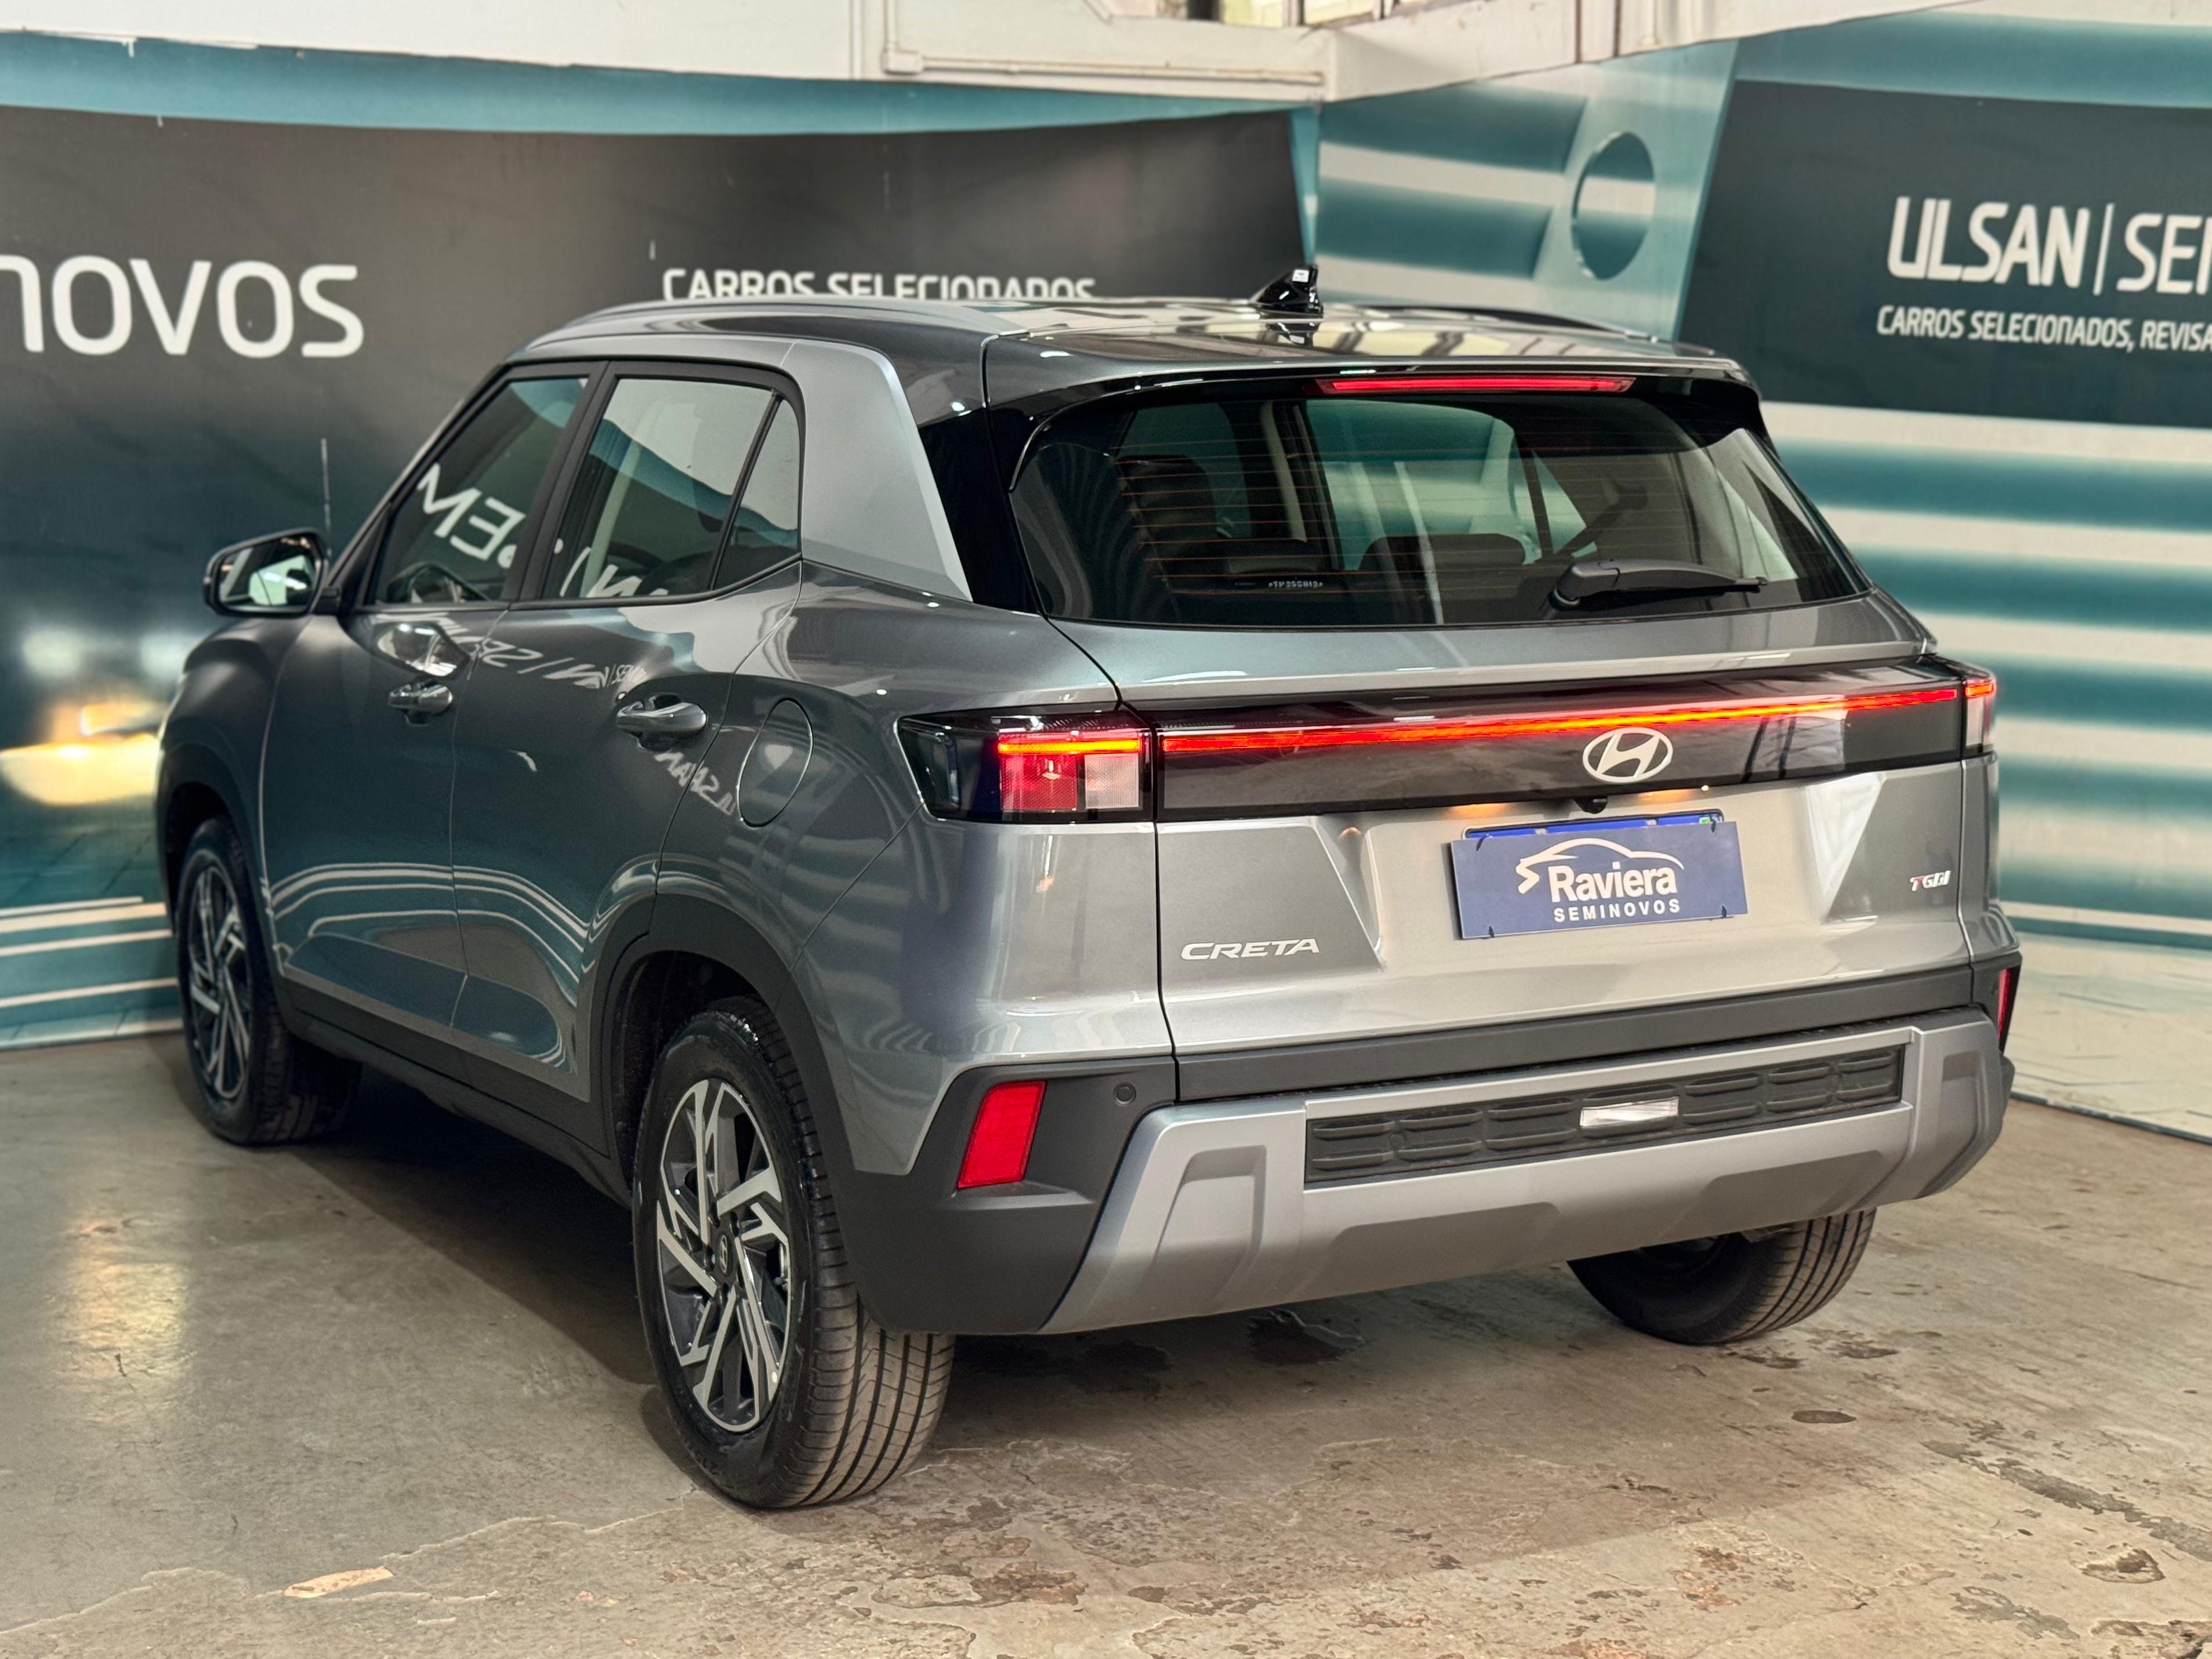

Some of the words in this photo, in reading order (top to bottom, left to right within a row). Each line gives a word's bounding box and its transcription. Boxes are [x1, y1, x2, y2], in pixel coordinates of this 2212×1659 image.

[1887, 196, 2091, 288] ULSAN
[1876, 305, 1966, 339] CARROS
[1968, 310, 2135, 353] SELECIONADOS,
[1547, 861, 1677, 903] Raviera
[1553, 898, 1680, 923] SEMINOVOS
[1181, 938, 1320, 960] CRETA
